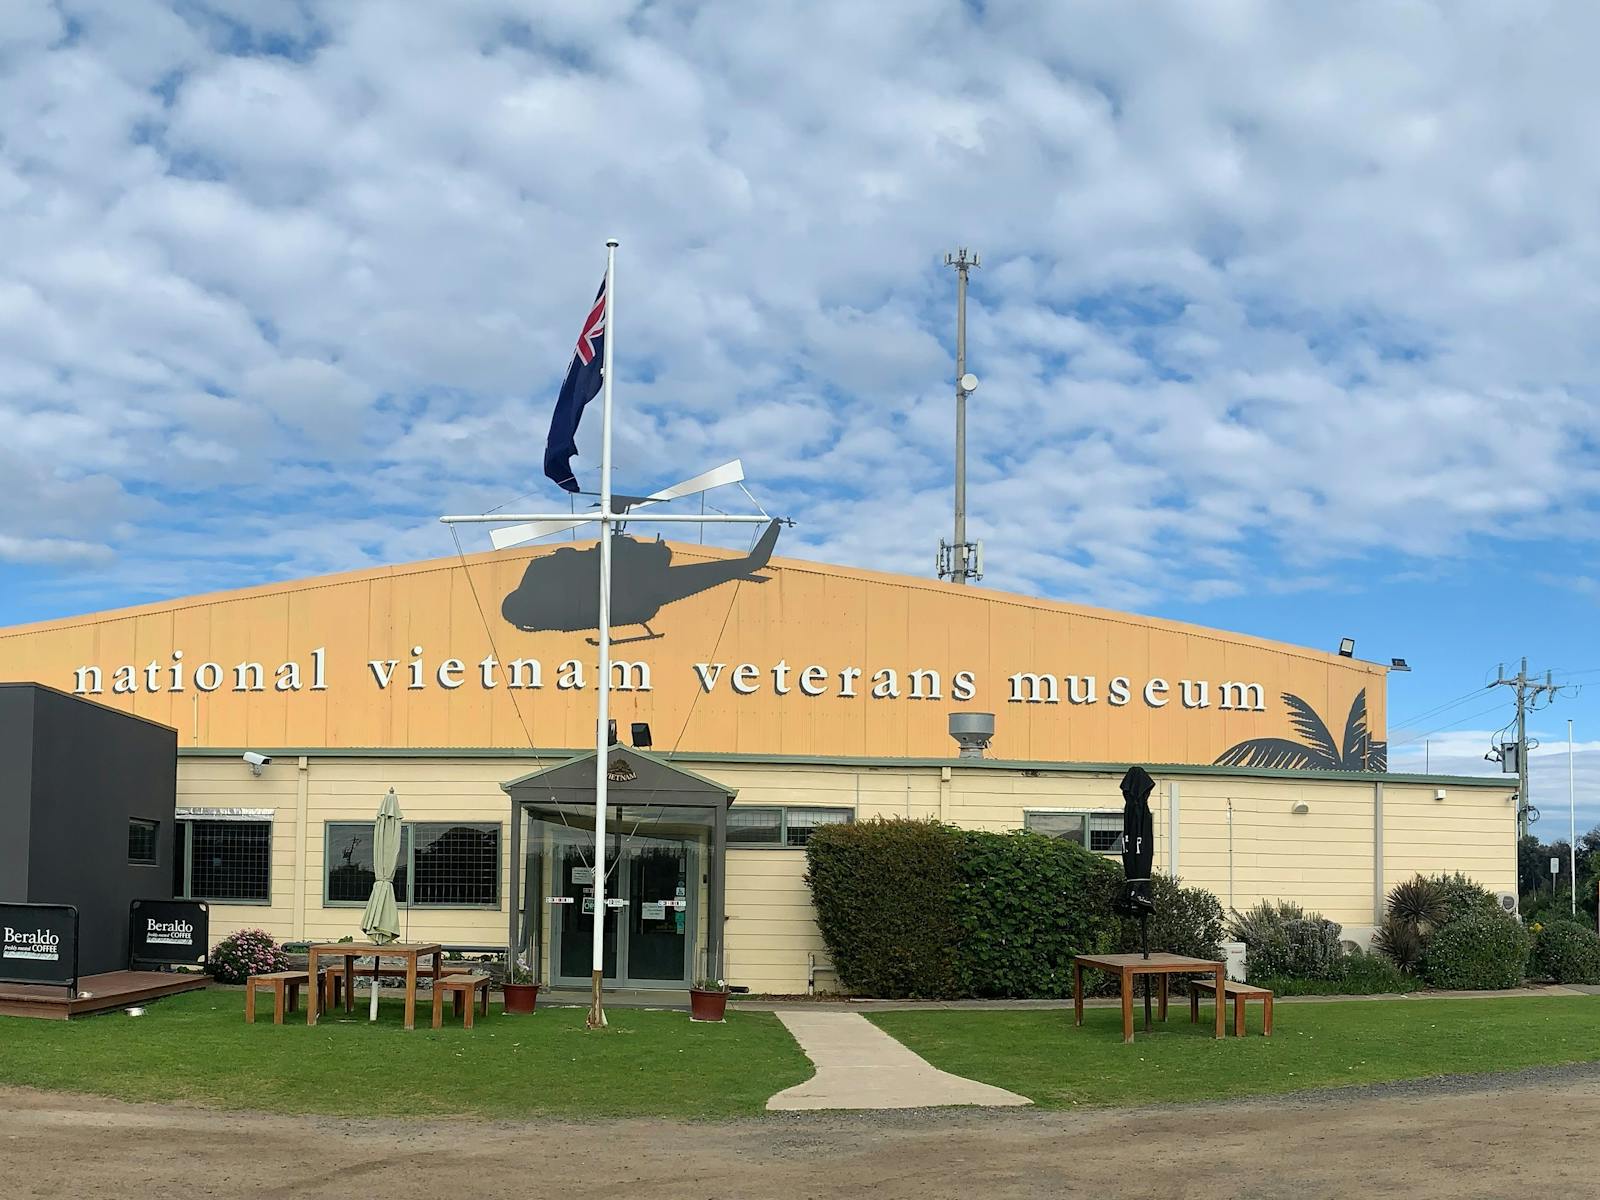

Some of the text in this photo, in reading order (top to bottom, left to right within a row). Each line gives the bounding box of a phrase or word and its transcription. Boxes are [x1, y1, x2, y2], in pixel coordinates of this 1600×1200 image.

[74, 646, 1267, 711] national vietnam veterans museum
[607, 771, 637, 781] IETNAM
[147, 918, 193, 933] Beraldo
[4, 927, 59, 945] Beraldo
[170, 931, 192, 939] COFFEE
[32, 944, 57, 953] COFFEE
